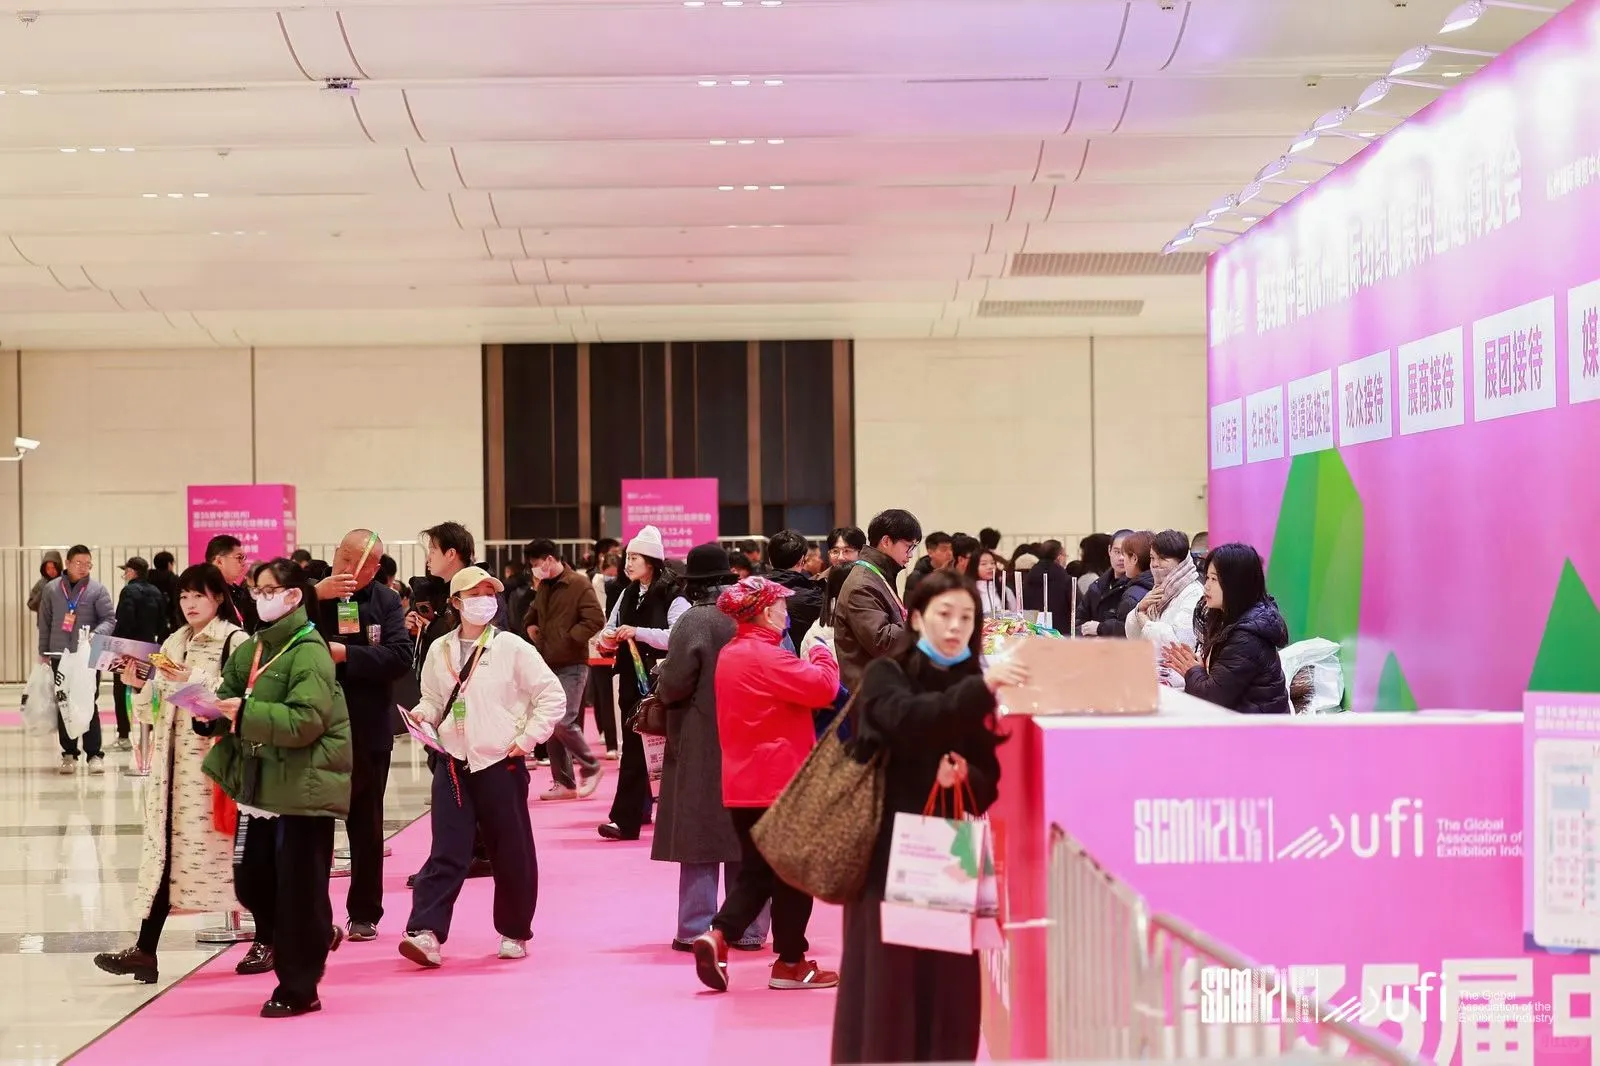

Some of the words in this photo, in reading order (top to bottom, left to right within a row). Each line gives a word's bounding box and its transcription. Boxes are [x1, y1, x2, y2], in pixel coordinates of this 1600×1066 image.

[1407, 352, 1454, 416] 展商接待
[1484, 324, 1543, 400] 展团接待
[1345, 371, 1384, 429] 观众接待
[1351, 798, 1423, 858] ufi
[1437, 819, 1460, 831] The
[1464, 818, 1504, 831] Global
[1437, 832, 1507, 844] Association
[1437, 845, 1496, 857] Exhibition
